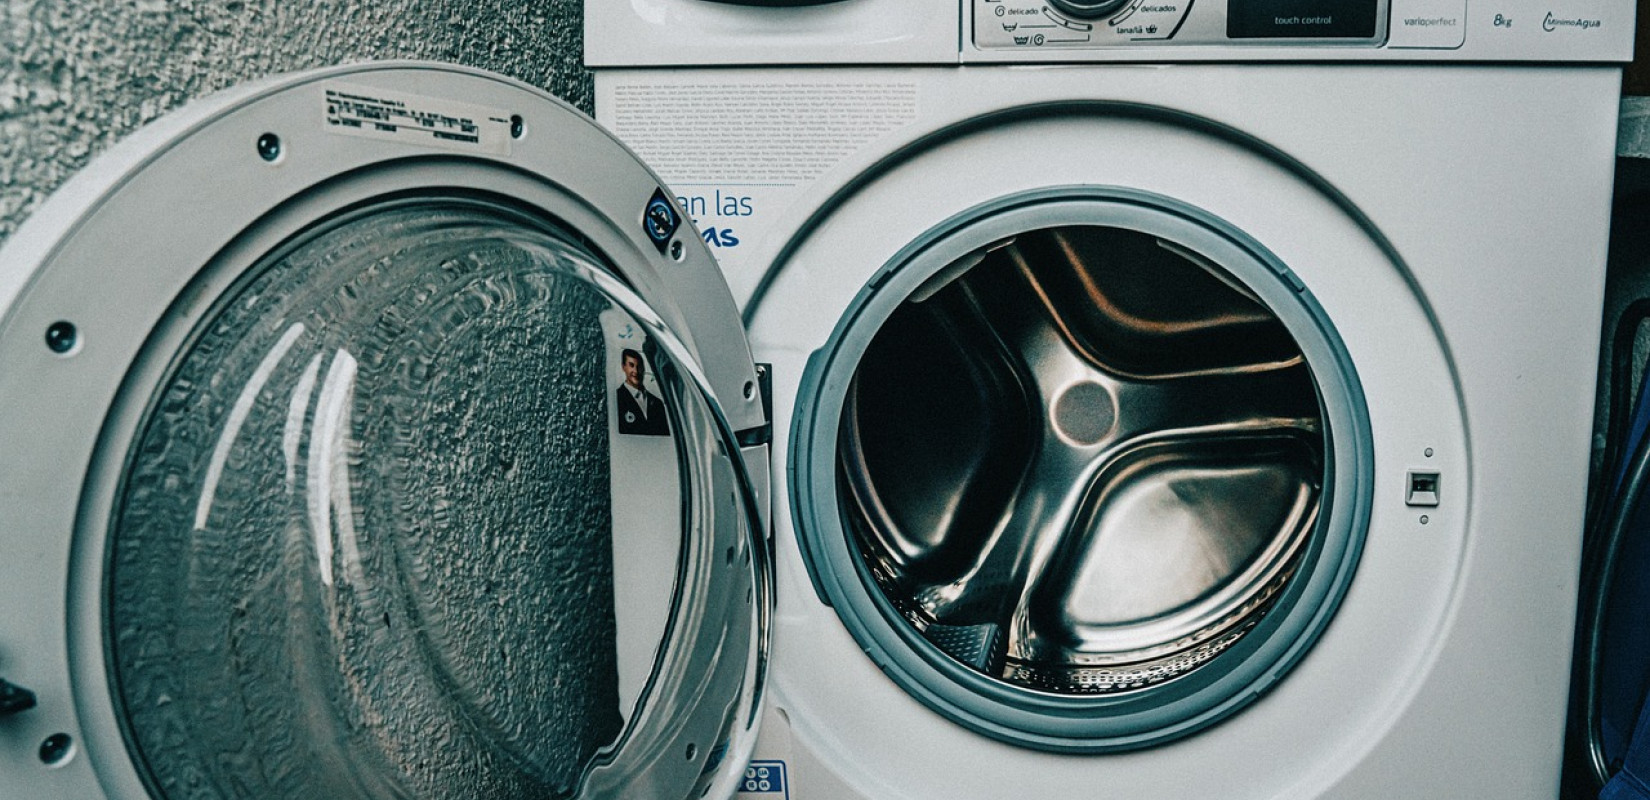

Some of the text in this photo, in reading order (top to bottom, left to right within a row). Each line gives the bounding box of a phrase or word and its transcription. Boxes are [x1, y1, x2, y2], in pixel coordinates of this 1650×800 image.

[1275, 16, 1331, 25] touch control
[1404, 17, 1456, 27] varioperfect
[1493, 13, 1512, 28] 8kg
[716, 189, 753, 216] las
